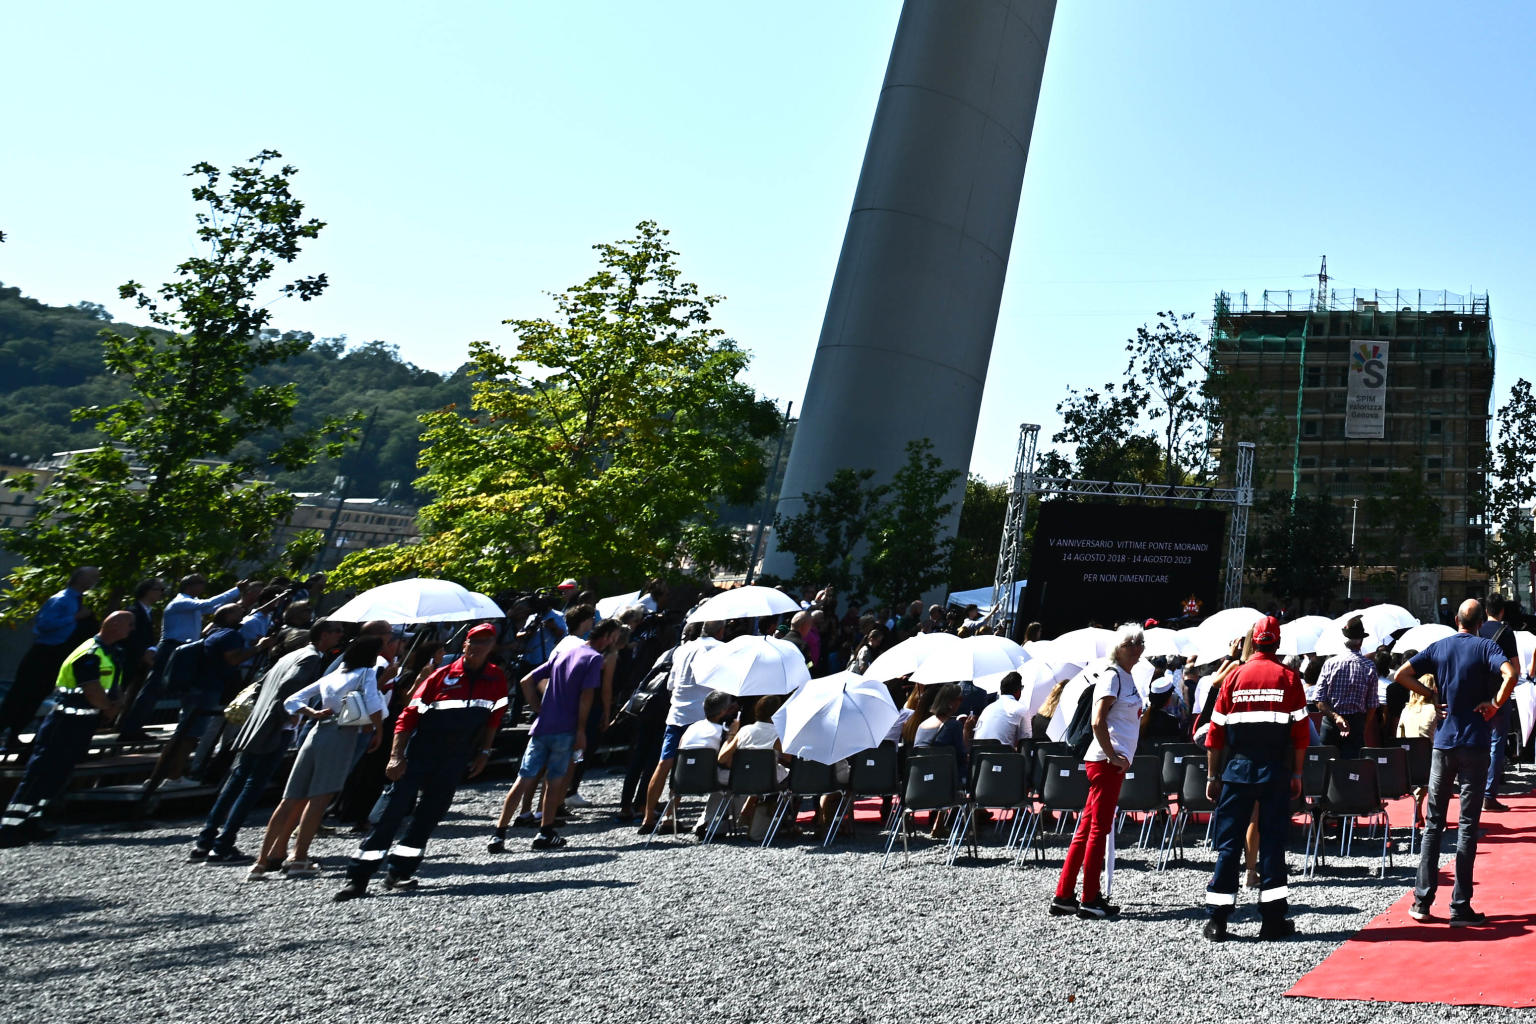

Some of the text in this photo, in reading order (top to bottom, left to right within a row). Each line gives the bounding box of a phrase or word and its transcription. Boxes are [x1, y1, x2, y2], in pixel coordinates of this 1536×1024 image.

[1356, 395, 1376, 403] SPIM
[1049, 538, 1209, 552] V ANNIVERSARIO VITTIME PONTE MORANDI
[1062, 553, 1072, 561] 14
[1073, 553, 1106, 562] AGOSTO
[1107, 554, 1127, 563] 2018
[1132, 554, 1141, 563] 14
[1142, 555, 1173, 564] AGOSTO
[1173, 556, 1192, 564] 2023
[1083, 573, 1169, 584] PER NON DIMENTICARE
[1232, 695, 1283, 703] CARABINIERI
